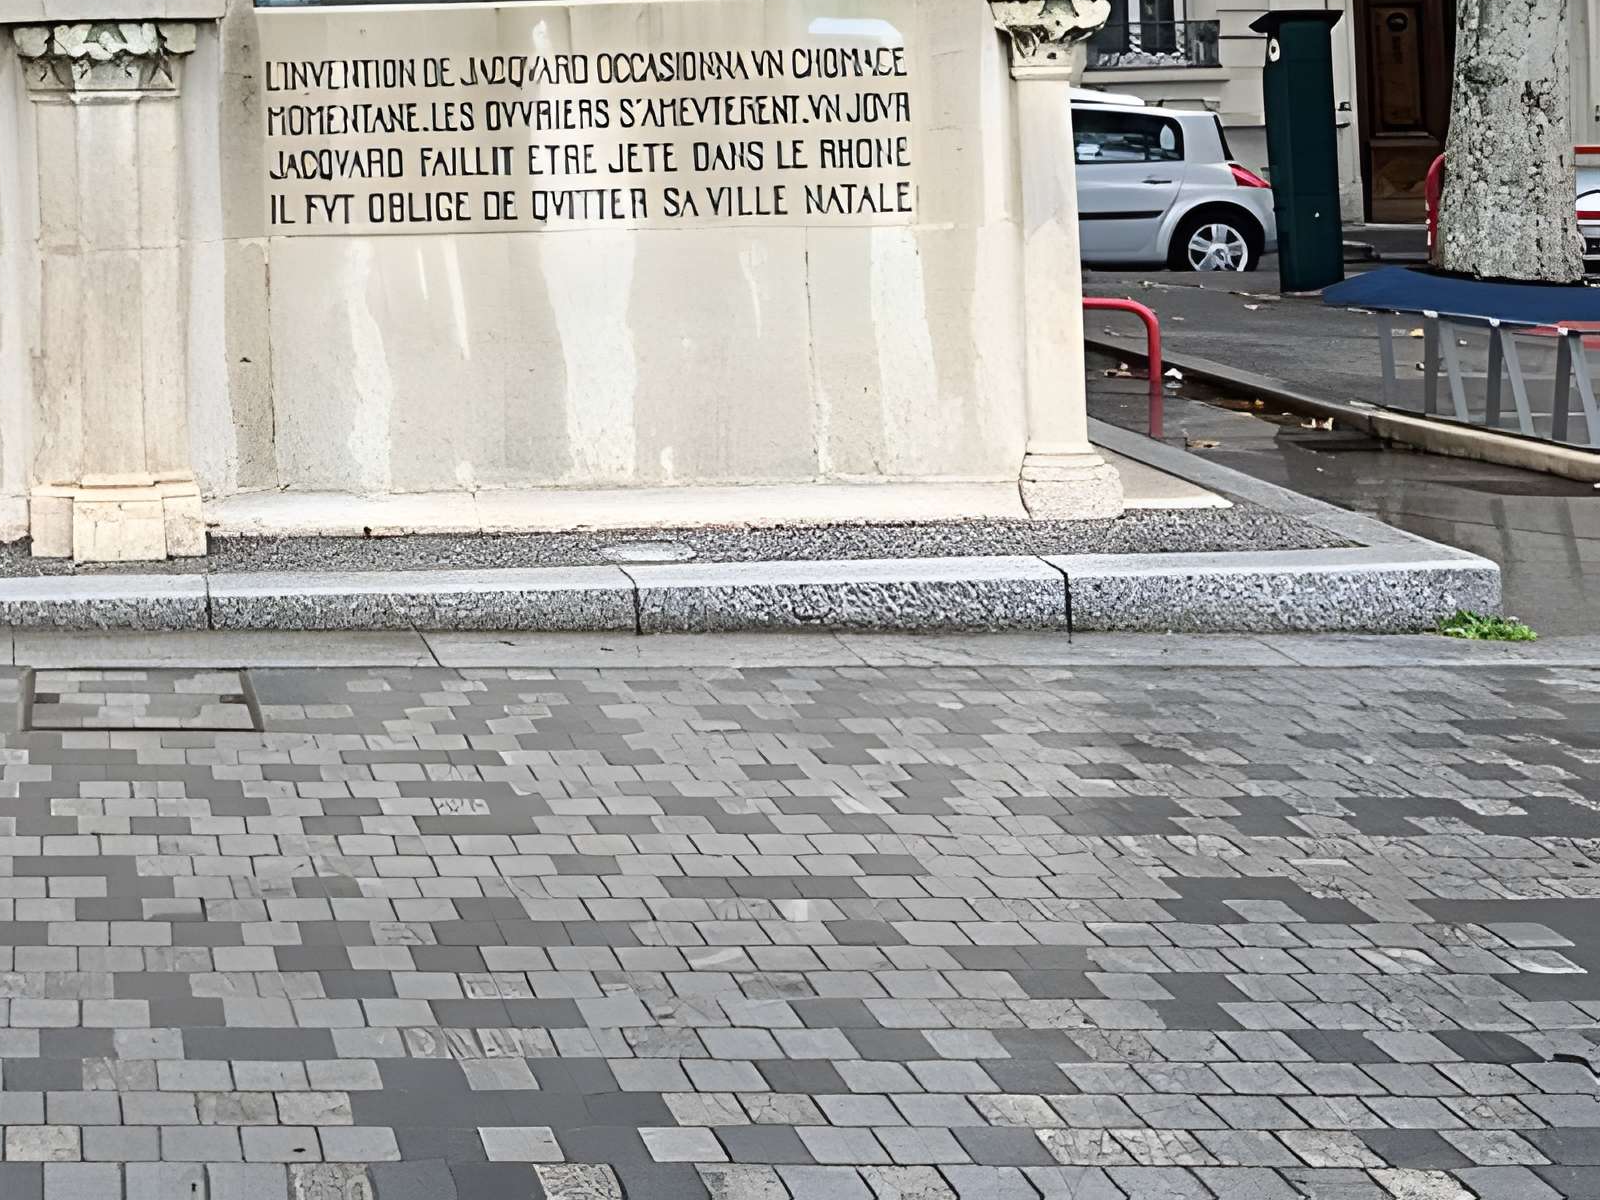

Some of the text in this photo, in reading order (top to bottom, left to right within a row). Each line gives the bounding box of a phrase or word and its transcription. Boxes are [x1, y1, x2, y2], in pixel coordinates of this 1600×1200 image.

[424, 58, 454, 87] DE
[460, 55, 588, 89] JACQVARD
[597, 51, 749, 83] OCCASIONNA
[751, 50, 783, 79] VN
[808, 94, 841, 122] VN
[846, 92, 911, 123] JOVR
[269, 137, 911, 180] JACQVARD FAILLIT ETRE JETE DANS LE RHONE
[271, 182, 912, 224] IL FVT OBLIGE DE QVITTER SA VILLE NATALE
